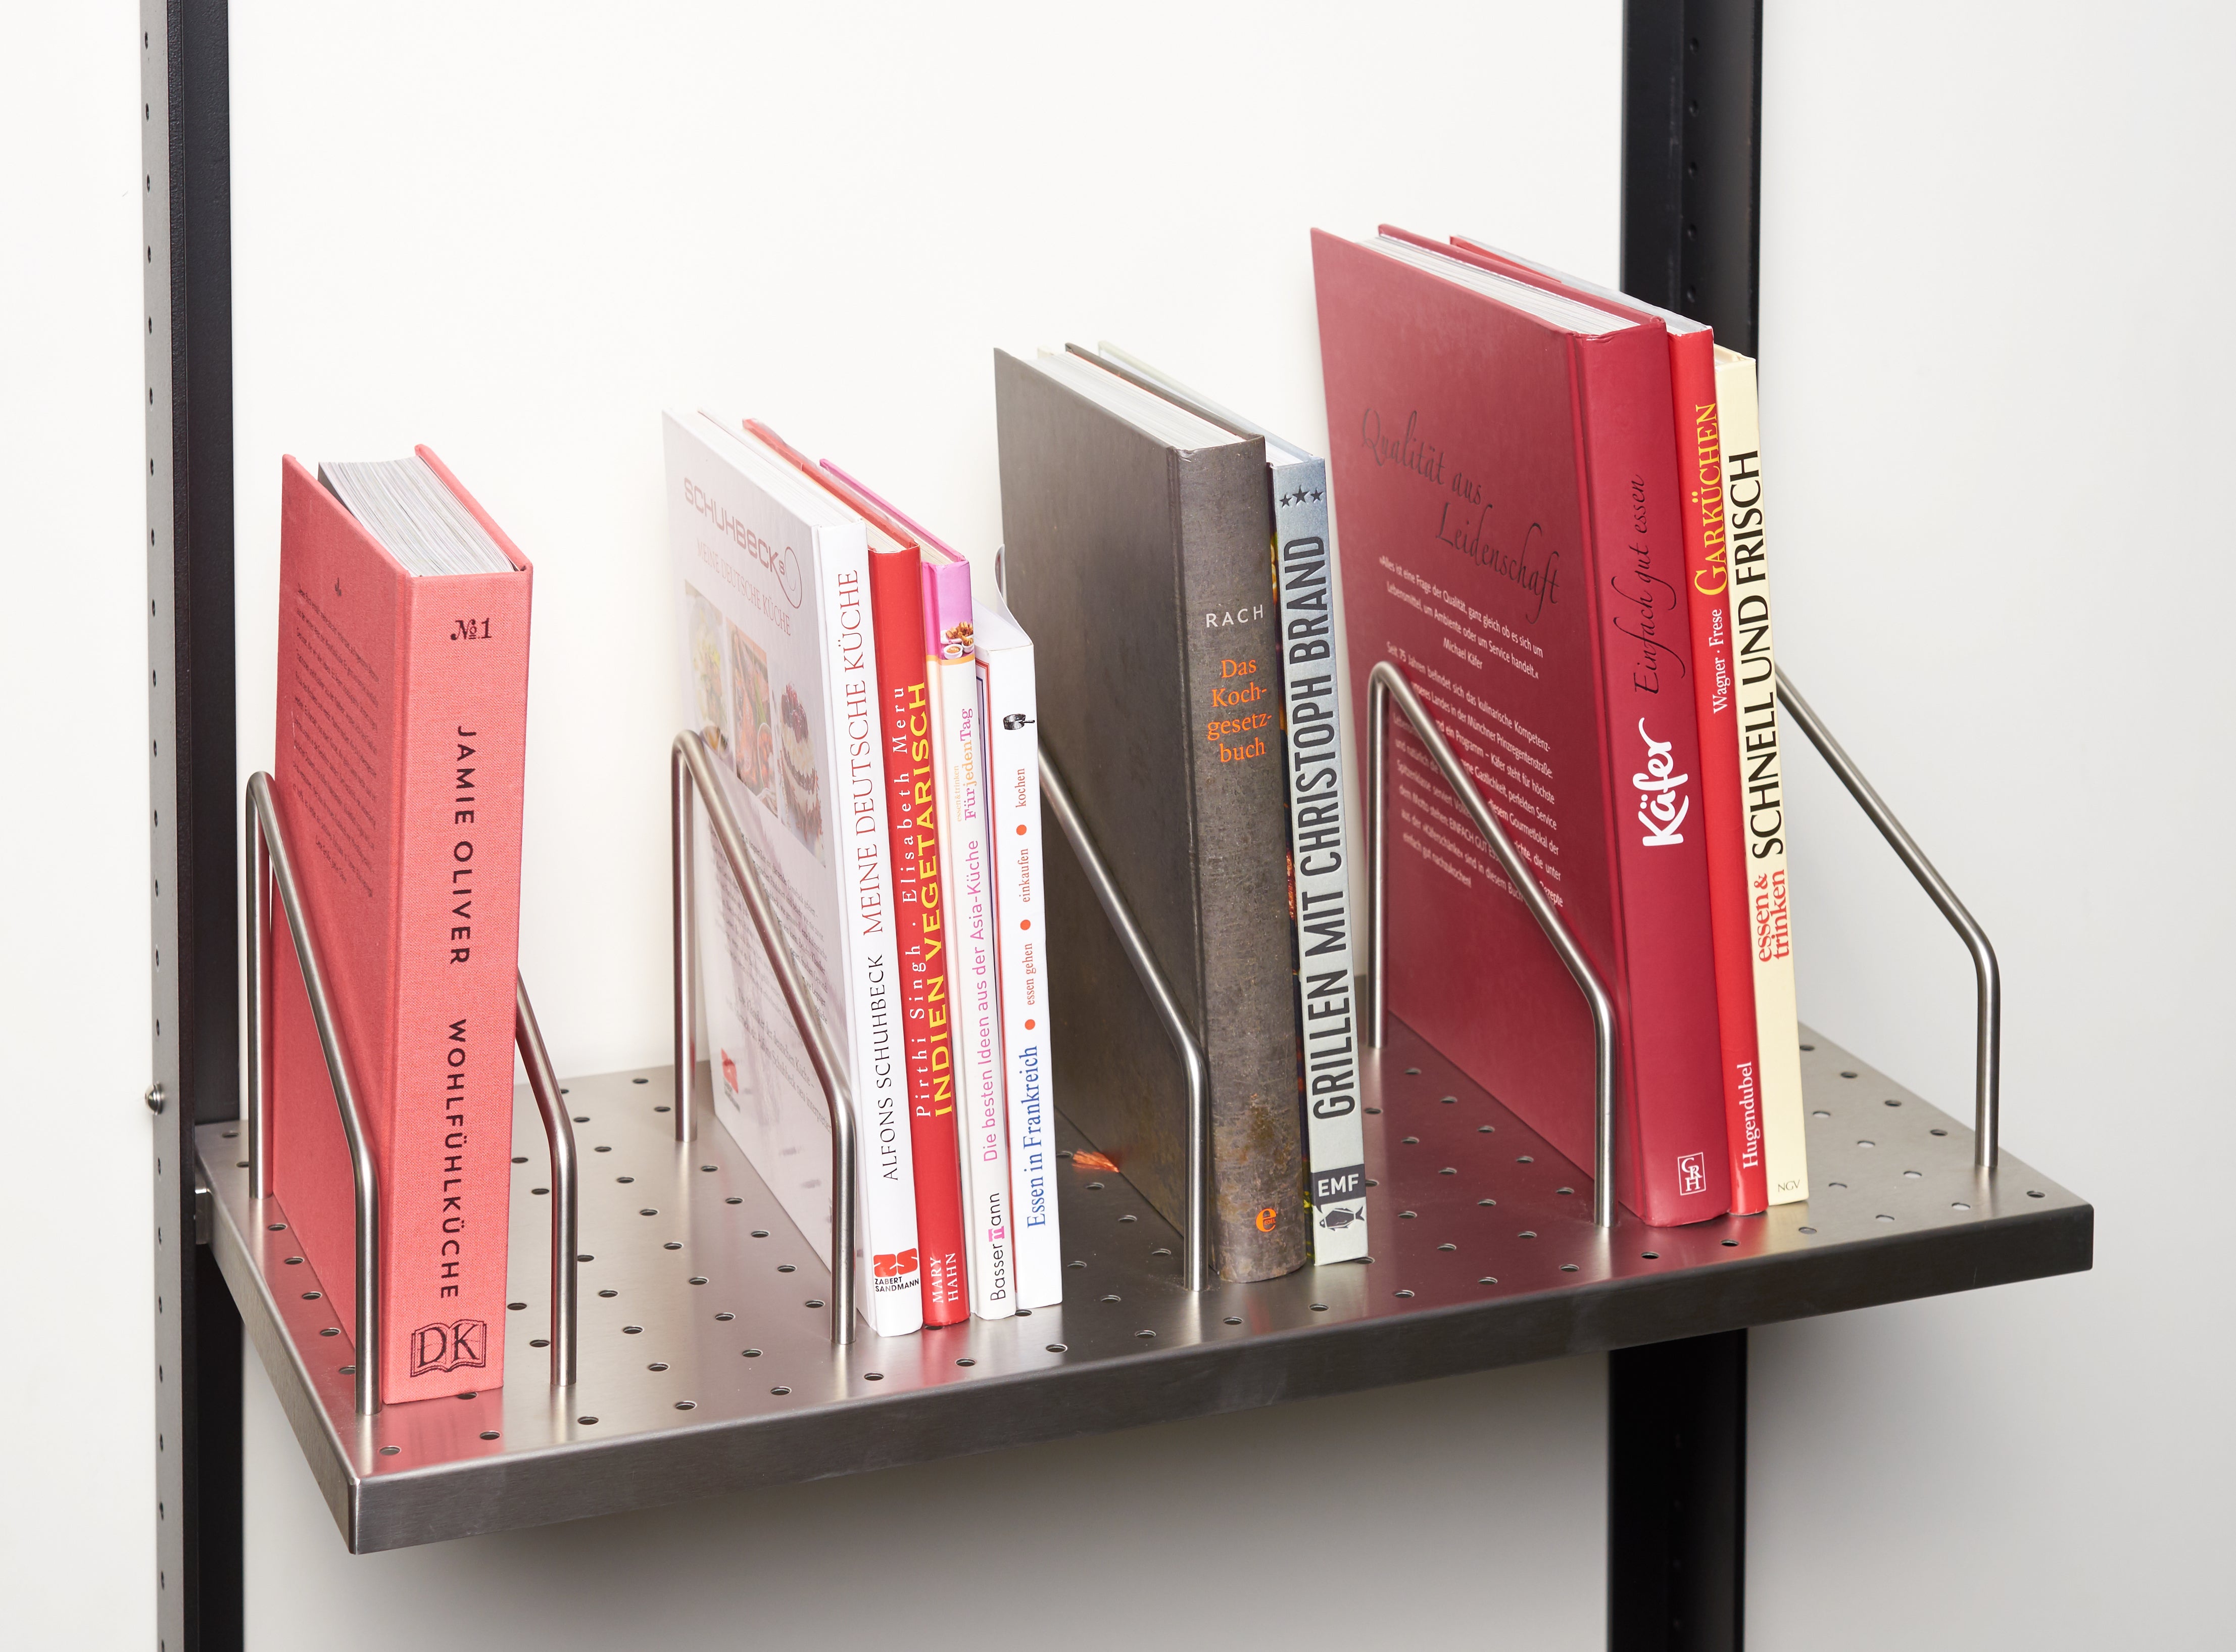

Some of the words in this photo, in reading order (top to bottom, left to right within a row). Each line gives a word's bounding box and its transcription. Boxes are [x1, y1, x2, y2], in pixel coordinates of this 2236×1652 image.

[1362, 408, 1445, 484] Qualität
[1452, 472, 1481, 505] aus
[1634, 474, 1648, 531] essen
[1692, 402, 1728, 596] GARKÜCHEN
[1728, 450, 1766, 585] FRISCH
[696, 539, 719, 572] MEINE
[721, 560, 761, 609] DEUTSCHE
[762, 592, 790, 635] KÜCHE
[1436, 503, 1560, 624] Leidenschaft
[837, 569, 864, 674] KÜCHE
[1206, 605, 1264, 628] RACH
[1283, 536, 1330, 665] BRAND
[1416, 575, 1432, 595] Frage
[1431, 584, 1442, 598] der
[1442, 590, 1468, 614] Qualität,
[1468, 607, 1482, 625] ganz
[1482, 612, 1501, 636] gleich
[1501, 623, 1510, 638] ob
[1511, 632, 1518, 643] es
[1519, 634, 1532, 650] sich
[1533, 644, 1543, 657] um
[1611, 575, 1685, 694] Einfach
[1709, 608, 1724, 646] Frese
[1221, 659, 1256, 678] Das
[1423, 605, 1433, 616] um
[1433, 608, 1462, 633] Ambiente
[1463, 625, 1477, 642] oder
[1477, 637, 1488, 648] um
[1488, 641, 1510, 661] Service
[1511, 654, 1539, 679] handelt.«
[1442, 637, 1467, 659] Michael
[1467, 651, 1483, 670] Käfer
[1737, 595, 1773, 684] UND
[892, 686, 908, 754] Meru
[1211, 686, 1268, 707] Koch-
[1398, 649, 1406, 661] 75
[1427, 666, 1451, 689] befindet
[1452, 682, 1465, 697] sich
[1465, 691, 1476, 705] das
[1477, 699, 1513, 728] kulinarische
[1514, 721, 1551, 755] Kompetenz-
[1713, 657, 1731, 714] Wagner
[845, 679, 877, 835] DEUTSCHE
[1207, 714, 1272, 741] gesetz-
[1220, 738, 1266, 763] buch
[1431, 693, 1450, 712] Landes
[1450, 705, 1456, 715] in
[1456, 708, 1467, 722] der
[1467, 715, 1496, 742] Münchner
[1496, 735, 1553, 781] Prinzregentenstraße:
[455, 725, 476, 824] JAMIE
[1015, 767, 1027, 807] kochen
[1291, 674, 1342, 877] CHRISTOPH
[1445, 724, 1455, 738] ein
[1455, 731, 1484, 760] Programm
[1490, 754, 1505, 771] Käfer
[1506, 764, 1521, 781] steht
[1522, 773, 1530, 787] für
[1532, 781, 1554, 803] höchste
[1474, 766, 1508, 797] Gastlichkeit,
[1508, 789, 1535, 817] perfekten
[1536, 807, 1557, 829] Service
[1632, 716, 1688, 847] Käfer
[1744, 692, 1784, 859] SCHNELL
[894, 772, 917, 903] Elisabeth
[907, 682, 943, 961] VEGETARISCH
[1448, 818, 1474, 843] EINFACH
[1474, 836, 1488, 853] GUT
[1509, 813, 1547, 847] Gourmetlokal
[1548, 840, 1559, 855] der
[450, 840, 473, 964] OLIVER
[857, 843, 883, 937] MEINE
[964, 840, 985, 940] Asia-Küche
[1017, 847, 1031, 902] einkaufen
[1464, 852, 1477, 868] sind
[1485, 867, 1506, 889] diesem
[1533, 853, 1543, 868] die
[1545, 862, 1561, 881] unter
[1302, 891, 1346, 962] MIT
[1756, 891, 1774, 962] essen
[1767, 869, 1788, 959] trinken
[905, 944, 926, 1021] Singh
[972, 947, 987, 975] der
[1023, 943, 1035, 975] gehen
[1026, 980, 1035, 1005] essen
[868, 954, 893, 1090] SCHUHBECK
[978, 983, 989, 1010] aus
[927, 975, 951, 1117] INDIEN
[978, 1013, 993, 1064] Ideen
[1306, 969, 1355, 1120] GRILLEN
[912, 1039, 931, 1118] Pirthi
[981, 1068, 995, 1127] besten
[1019, 1045, 1042, 1149] Frankreich
[879, 1098, 898, 1181] ALFONS
[984, 1131, 997, 1161] Die
[1736, 1061, 1761, 1169] Hugendubel
[441, 1018, 467, 1299] WOHLFÜHLKÜCHE
[1024, 1152, 1043, 1172] in
[1317, 1173, 1359, 1197] EMF
[1778, 1180, 1800, 1193] NGV
[1028, 1176, 1046, 1228] Essen
[874, 1276, 902, 1285] ZABERT
[876, 1278, 919, 1292] SANDMANN
[932, 1256, 944, 1303] MARY
[945, 1252, 959, 1301] HAHN
[419, 1322, 478, 1368] DK
